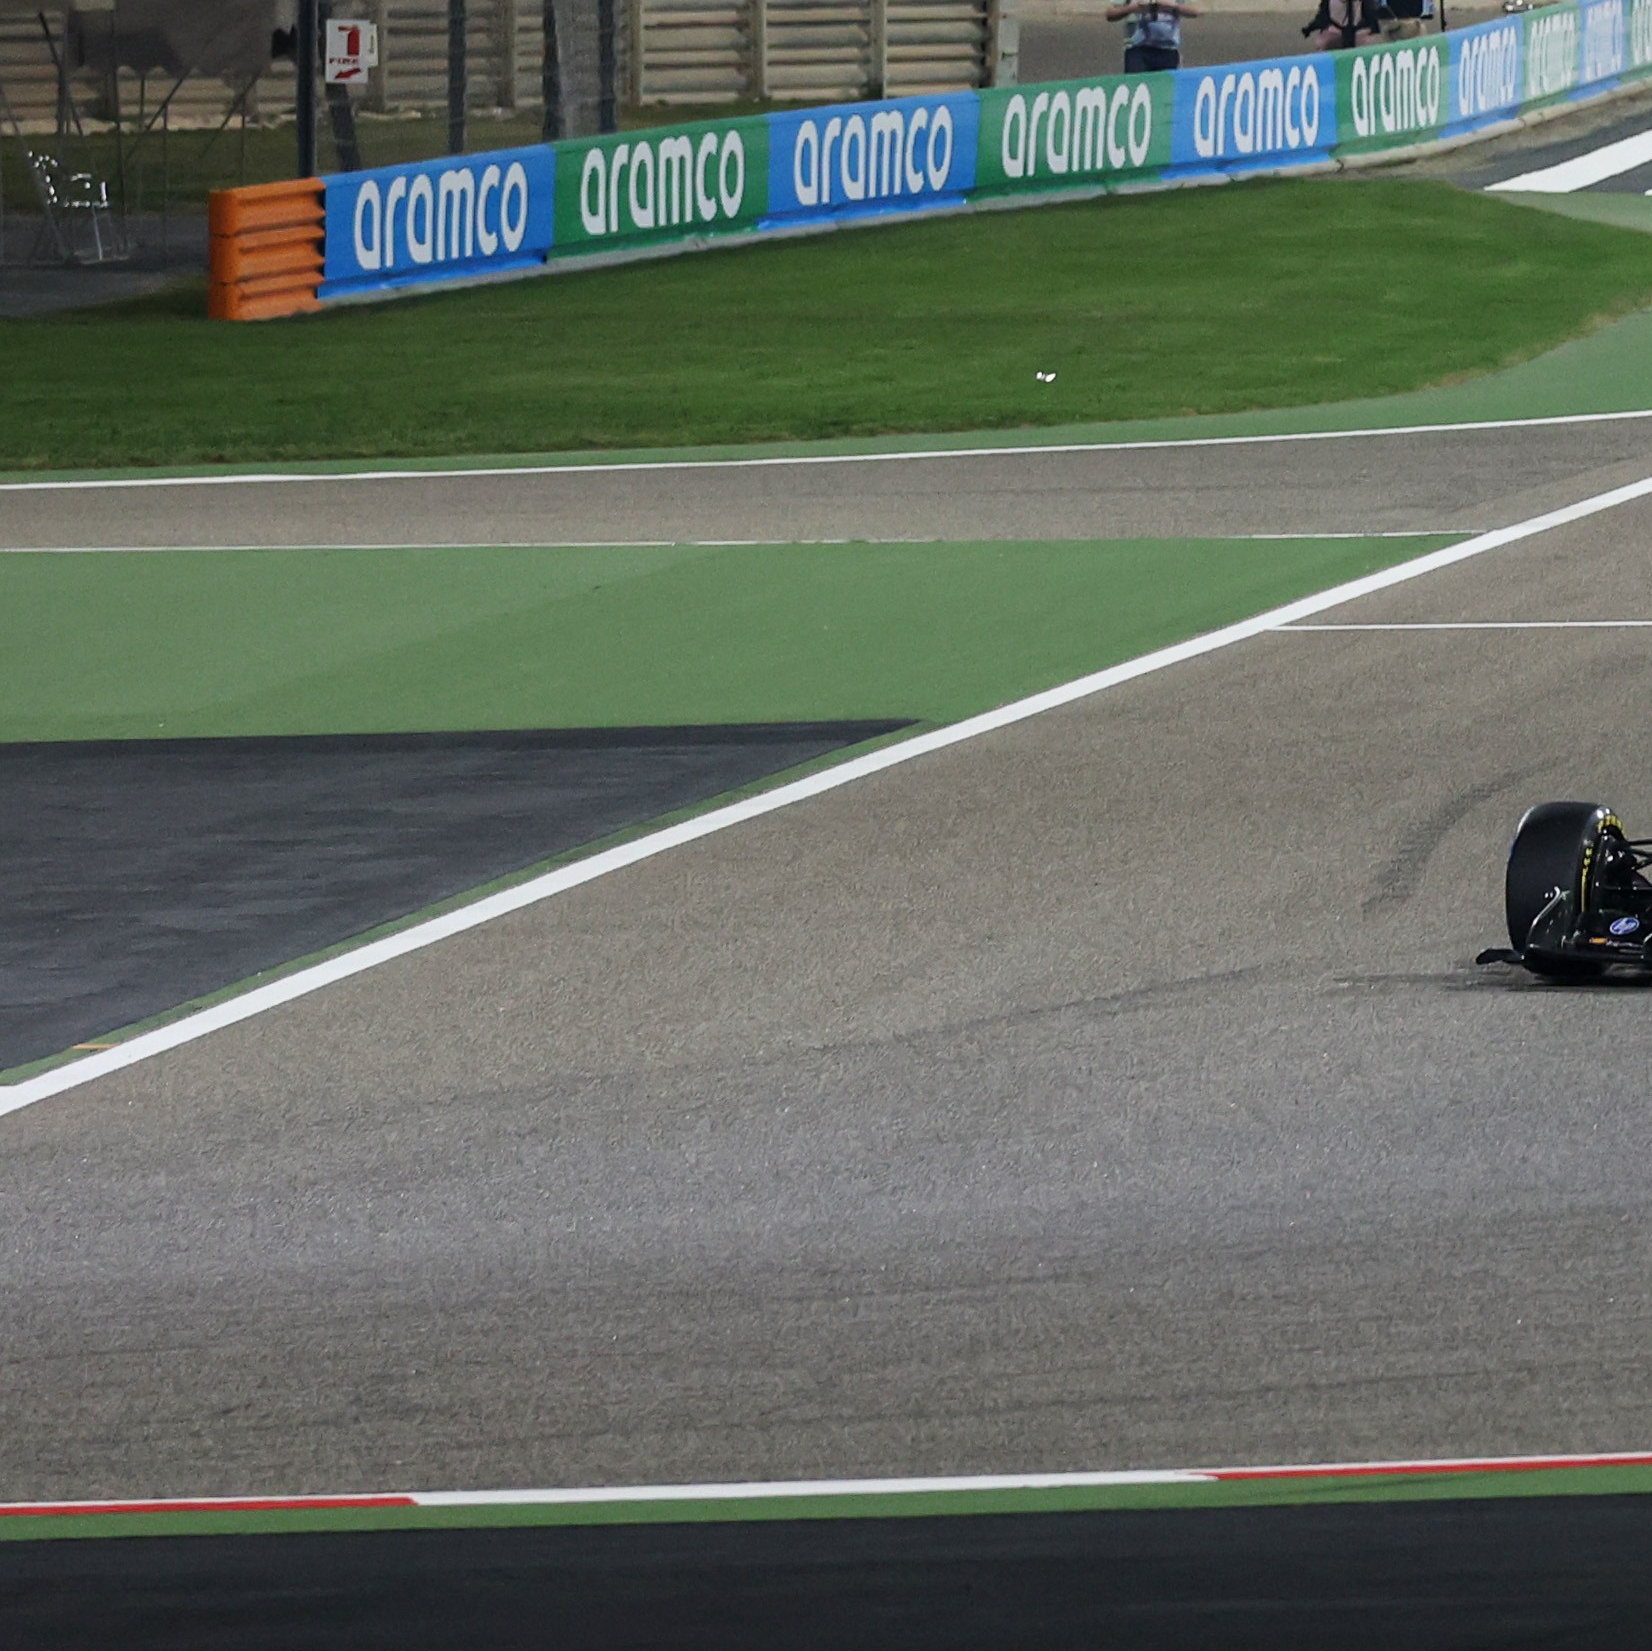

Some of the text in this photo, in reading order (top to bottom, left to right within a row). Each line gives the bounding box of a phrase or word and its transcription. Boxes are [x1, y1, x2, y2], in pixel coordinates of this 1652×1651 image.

[1194, 65, 1320, 158] aramco
[1351, 45, 1441, 138] aramco
[1459, 25, 1518, 117] aramco
[794, 104, 954, 208] aramco
[1001, 82, 1152, 179] aramco
[354, 162, 529, 270] aramco
[580, 128, 746, 237] aramco
